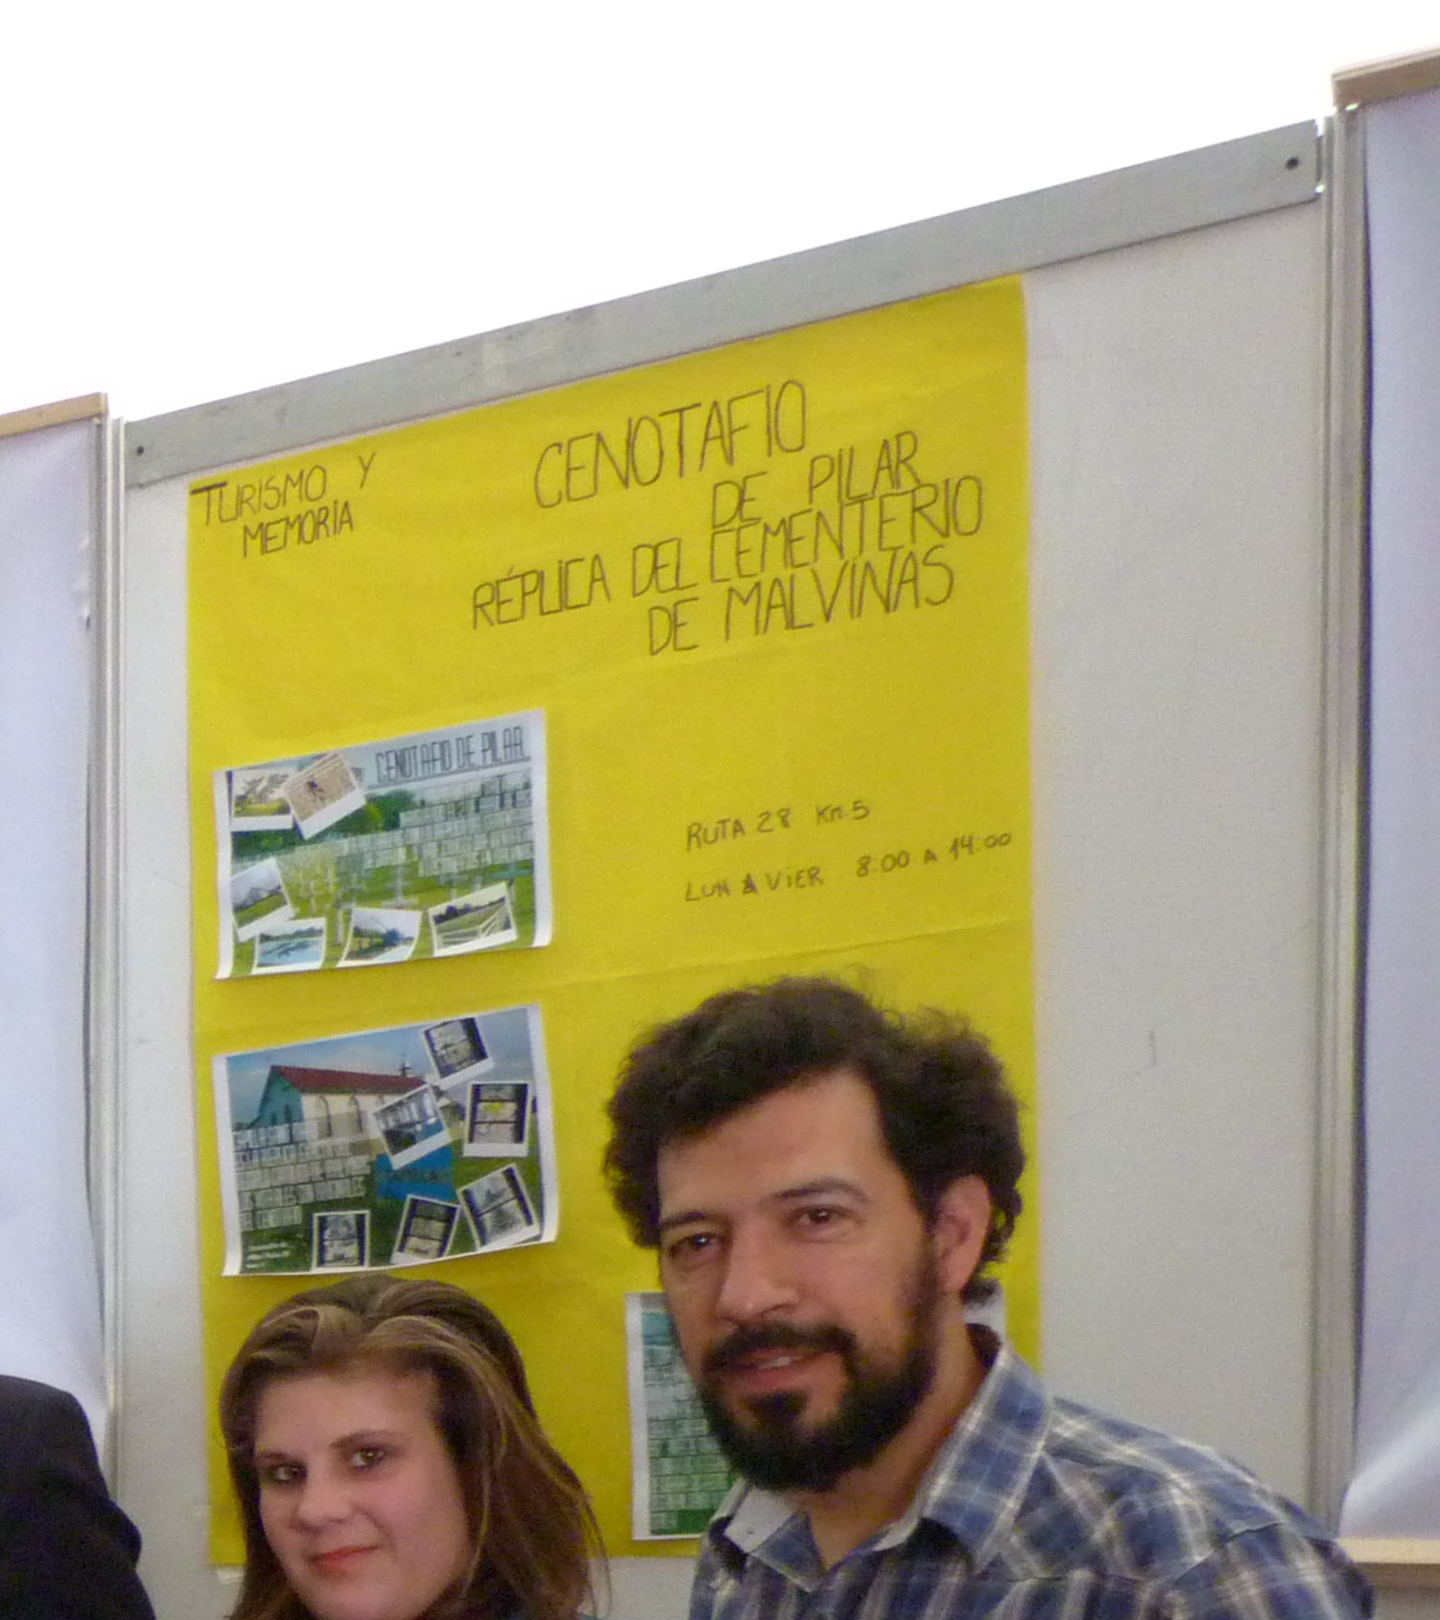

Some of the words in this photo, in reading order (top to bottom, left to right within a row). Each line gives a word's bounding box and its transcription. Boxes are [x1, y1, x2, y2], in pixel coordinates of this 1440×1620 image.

[534, 379, 807, 509] CENOTAFIO
[711, 471, 768, 530] DE
[808, 430, 922, 504] PILAR
[189, 464, 328, 526] TURISMO
[358, 452, 376, 489] Y
[243, 499, 354, 559] MEMORIA
[632, 537, 699, 598] DEL
[710, 475, 983, 583] CEMENTERIO
[648, 597, 700, 656] DE
[726, 543, 955, 642] MALVINAS
[455, 735, 475, 769] DE
[481, 726, 525, 764] PILAR
[686, 818, 747, 852] RUTA
[757, 807, 792, 834] 28
